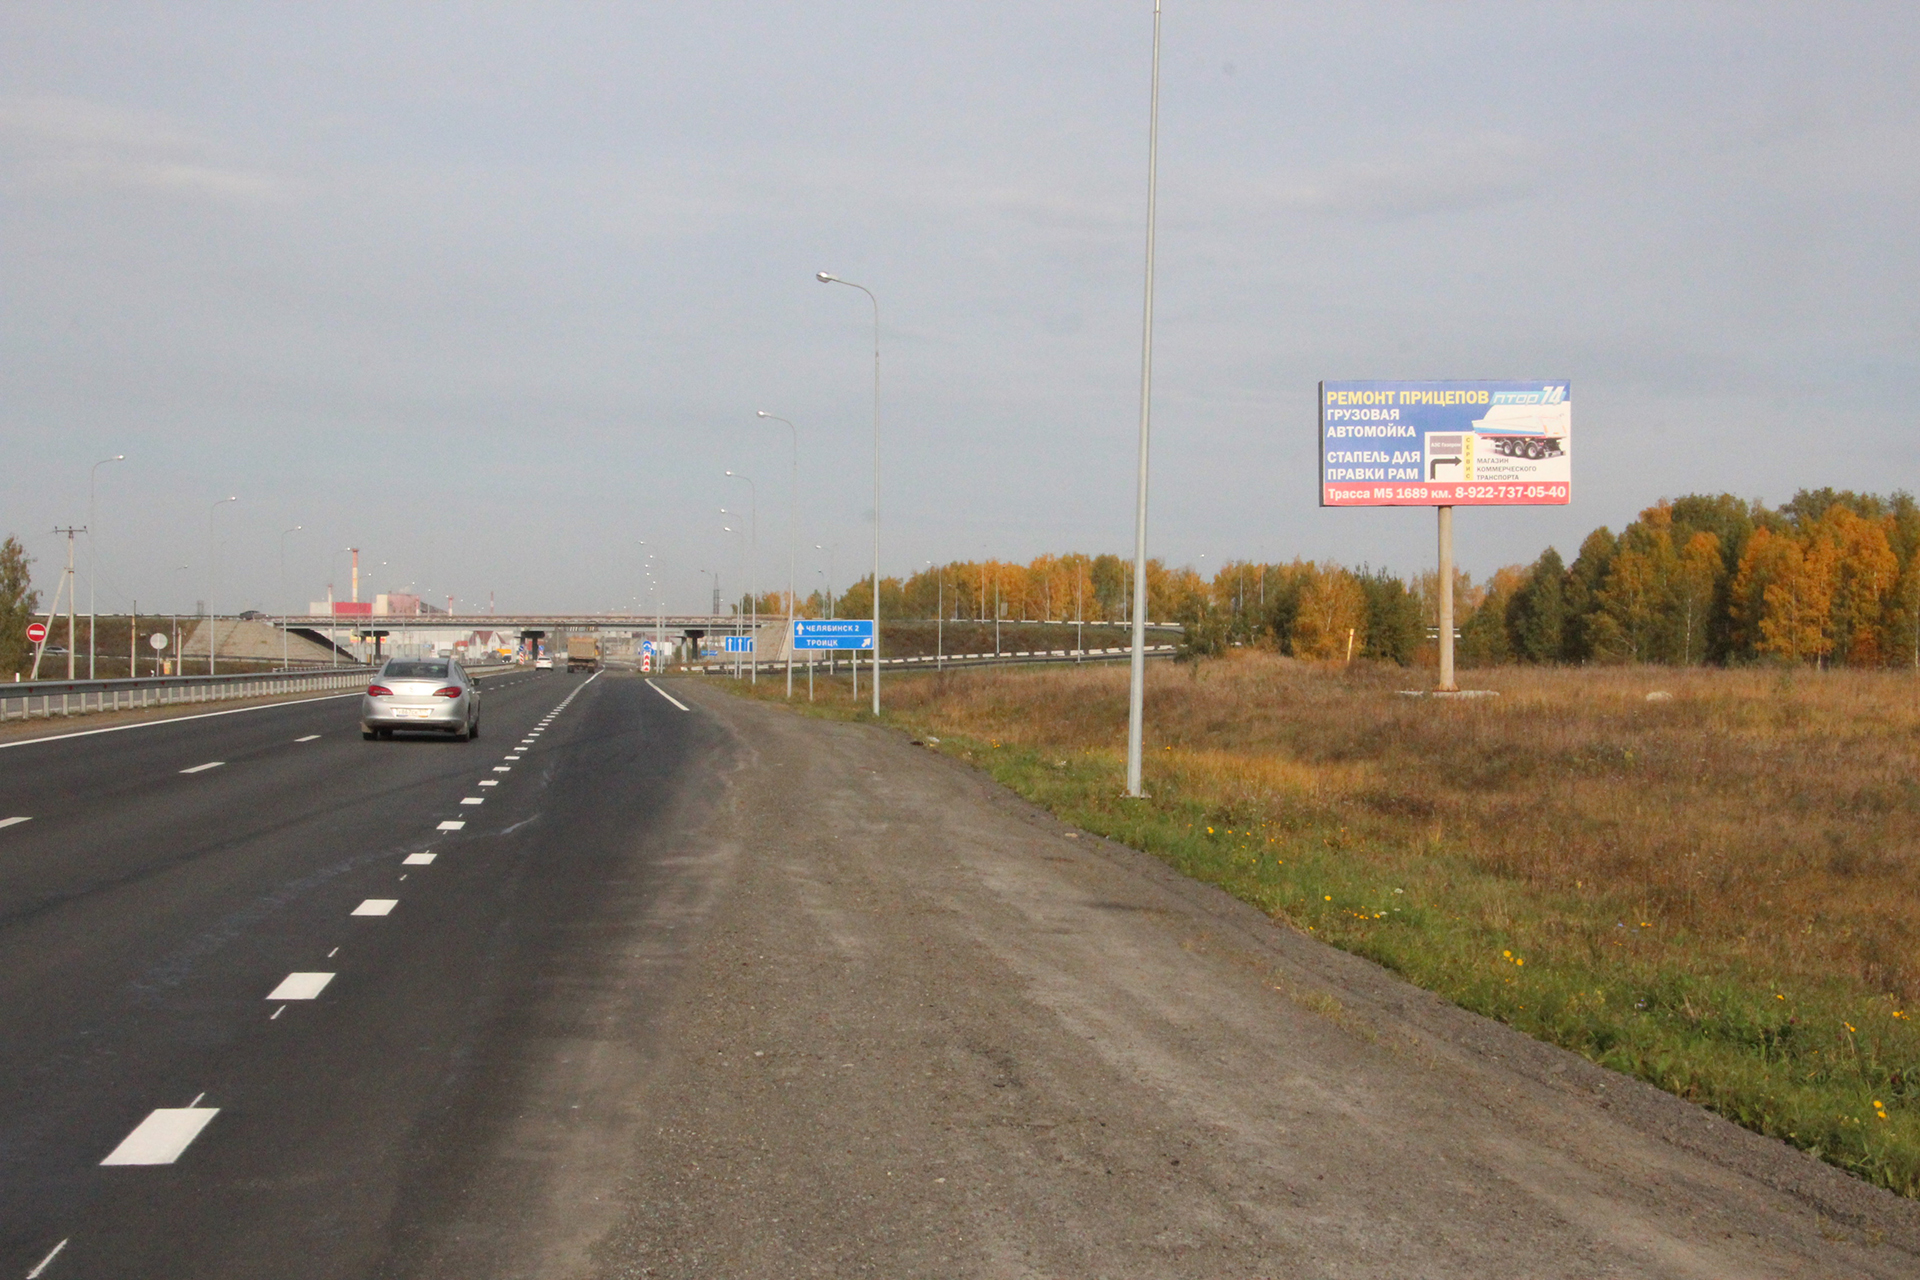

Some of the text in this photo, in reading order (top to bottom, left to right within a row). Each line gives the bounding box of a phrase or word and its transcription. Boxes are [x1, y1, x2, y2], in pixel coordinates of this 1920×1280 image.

[1327, 391, 1489, 407] РЕМОНТ ПРИЦЕПОВ
[1327, 408, 1400, 421] ГРУЗОВАЯ
[1326, 423, 1416, 438] АВТОМОЙКА
[1327, 451, 1421, 464] СТАПЕЛЬ ДЛЯ
[1327, 468, 1419, 480] ПРАВКИ РАМ
[1328, 486, 1567, 501] Трасса М5 1689 км. 8-922-737-05-40
